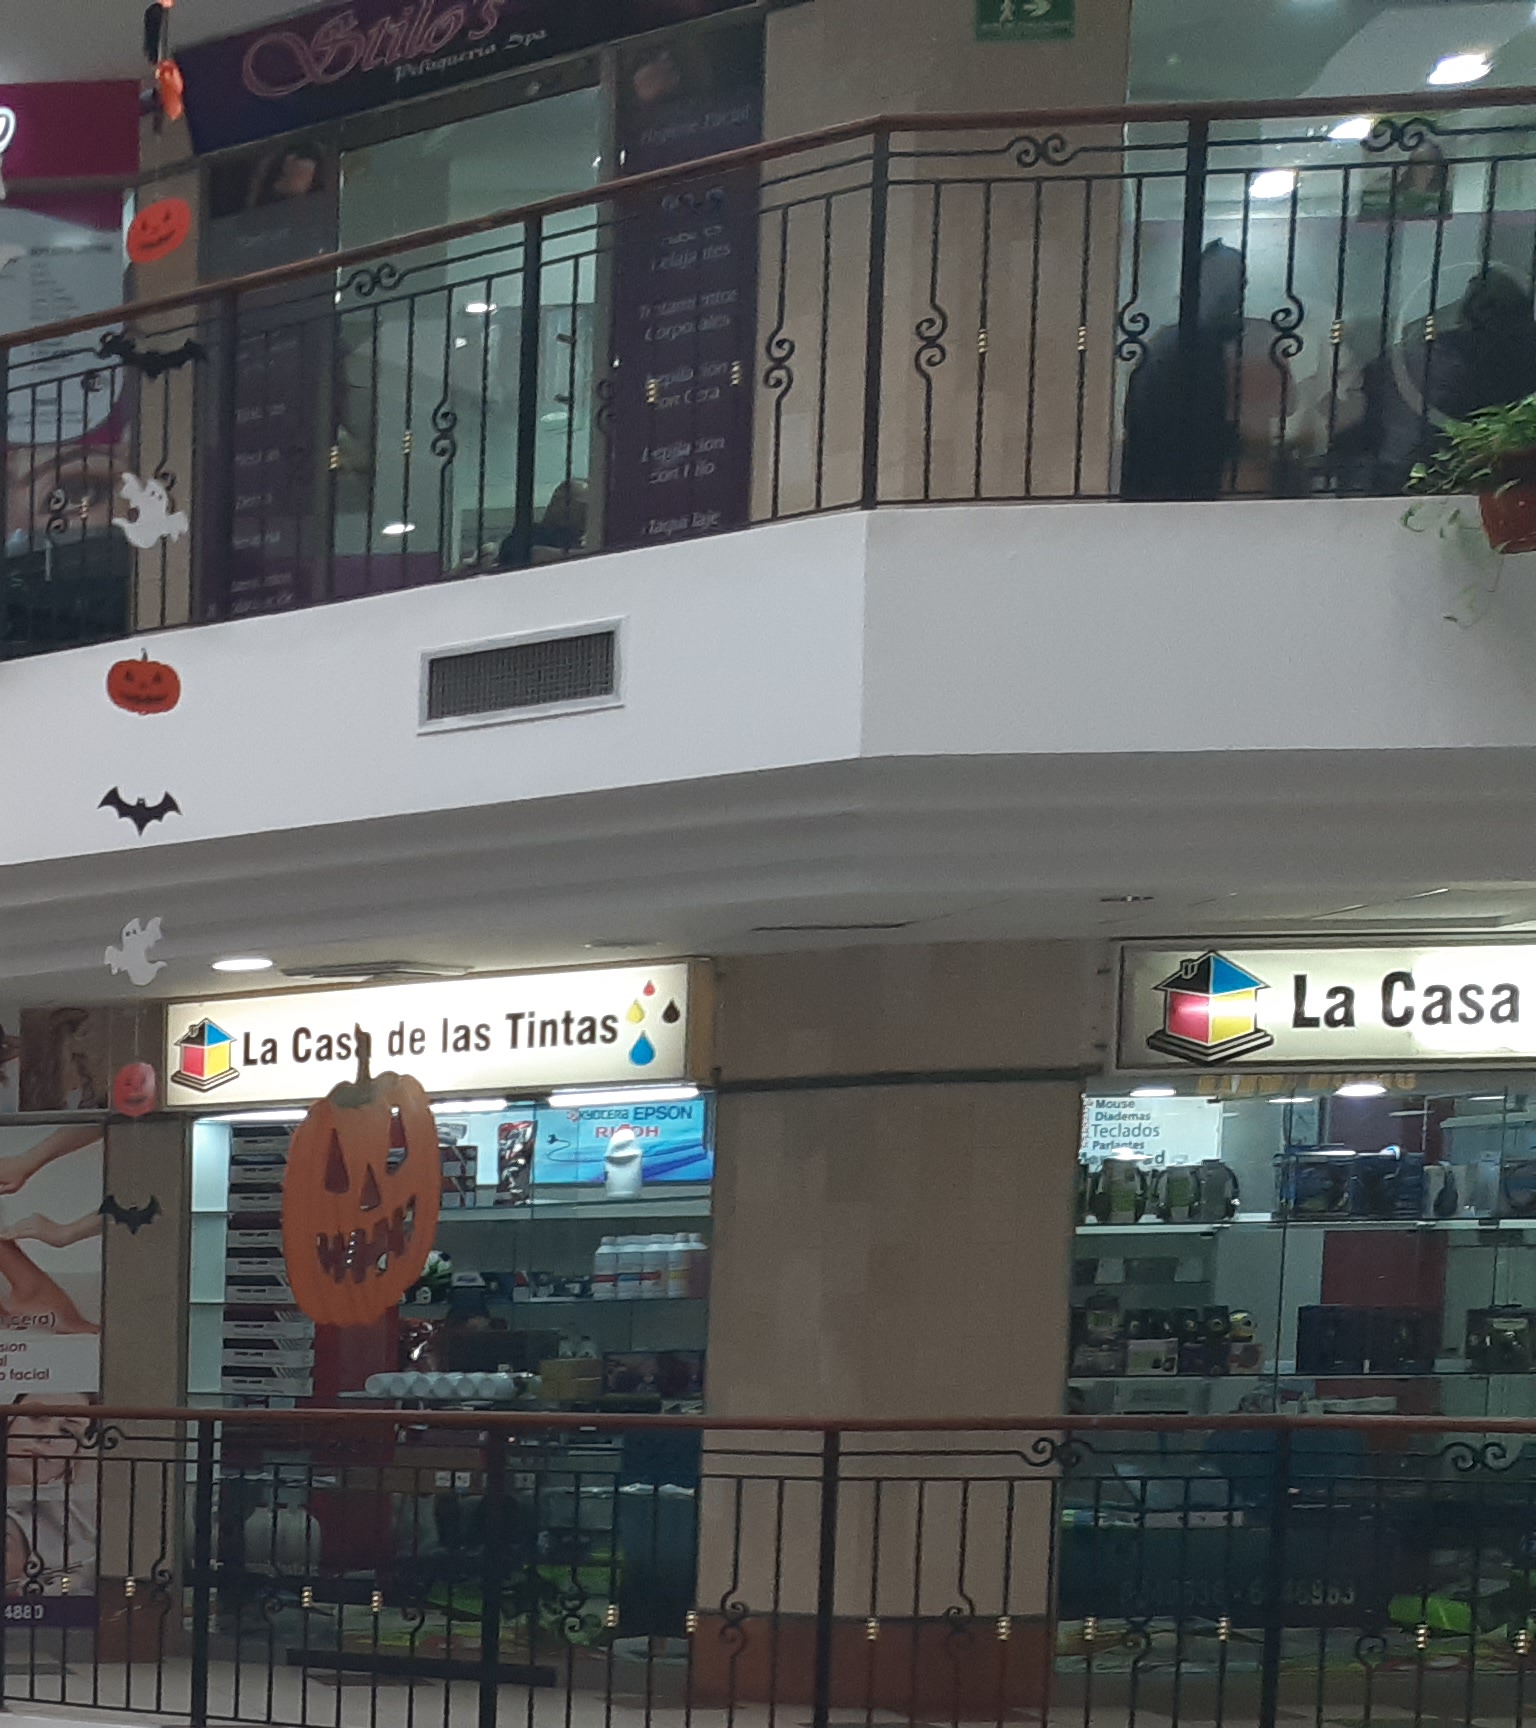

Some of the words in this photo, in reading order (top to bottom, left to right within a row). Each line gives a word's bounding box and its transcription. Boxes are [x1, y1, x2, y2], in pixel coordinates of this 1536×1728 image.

[1292, 973, 1356, 1028] La
[1381, 971, 1520, 1027] Casa
[242, 1031, 278, 1066] La
[387, 1021, 426, 1057] de
[441, 1018, 491, 1053] las
[505, 1010, 619, 1050] Tintas
[633, 1105, 693, 1120] EPSON
[595, 1125, 659, 1138] RIOH
[1091, 1123, 1160, 1138] Teclados
[10, 1368, 50, 1380] facial
